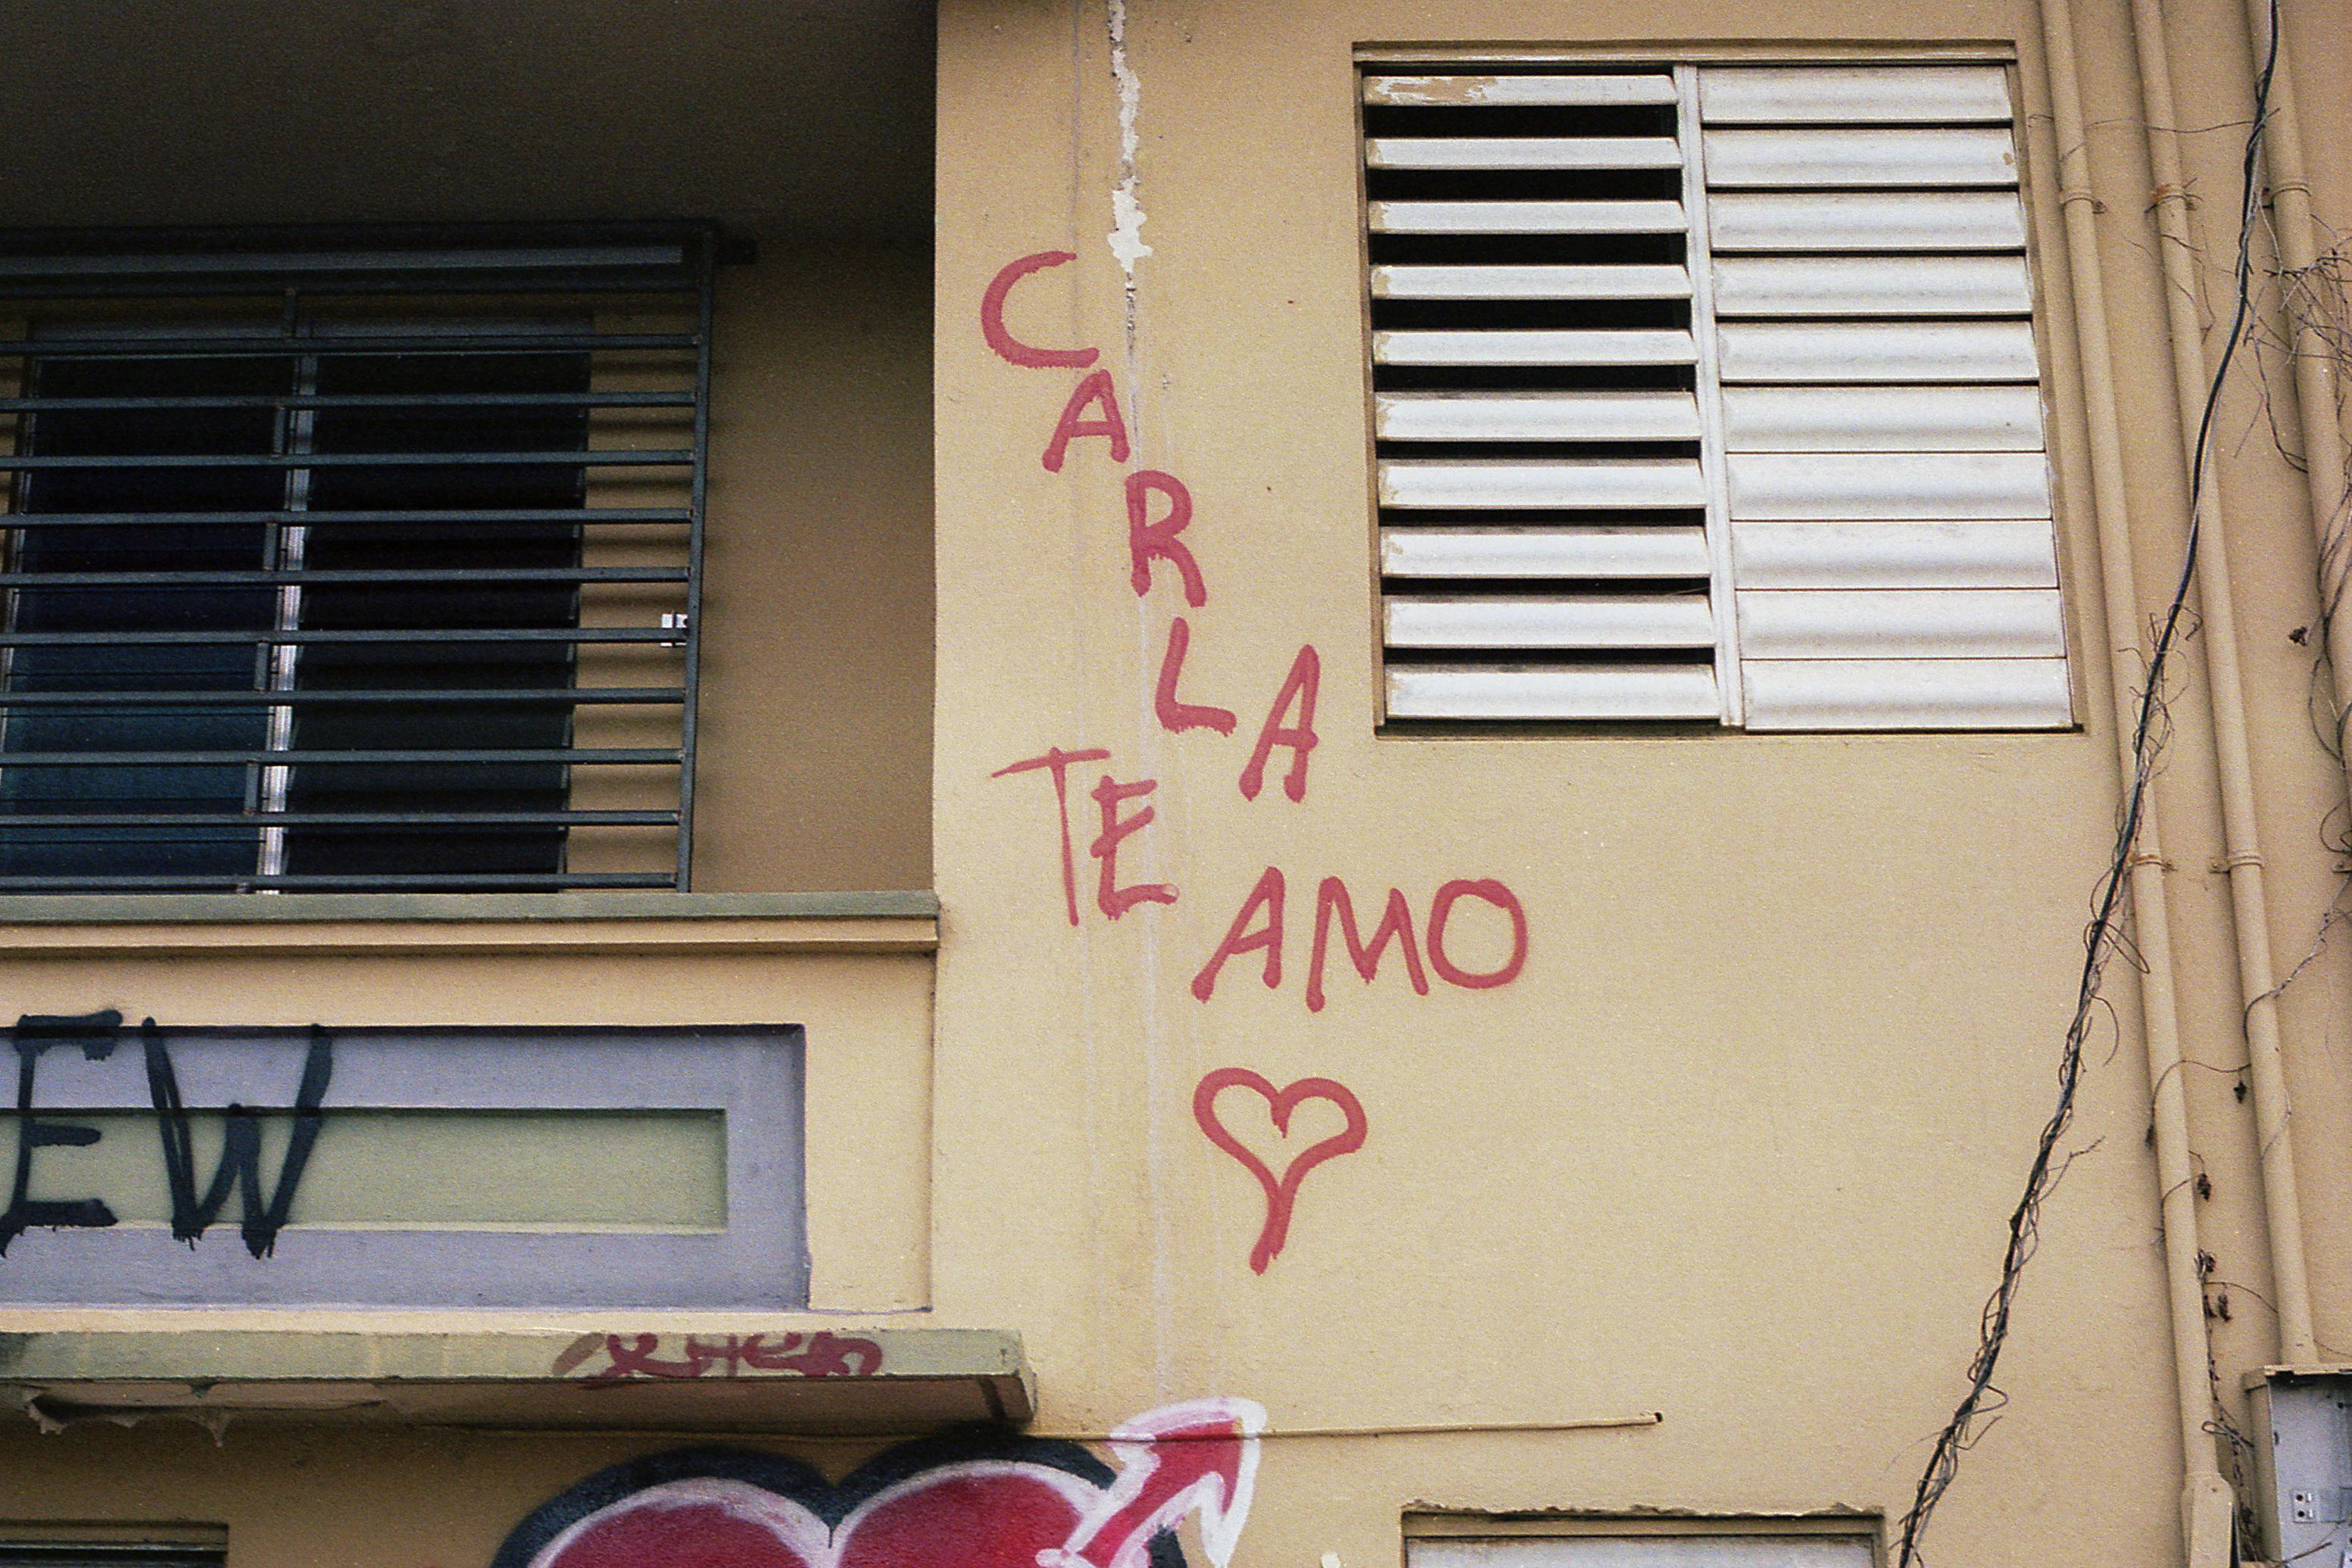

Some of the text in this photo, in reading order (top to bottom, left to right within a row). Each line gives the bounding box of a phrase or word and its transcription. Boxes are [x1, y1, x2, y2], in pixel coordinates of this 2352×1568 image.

[980, 251, 1320, 803] CARLA
[990, 746, 1528, 1012] TE AMO
